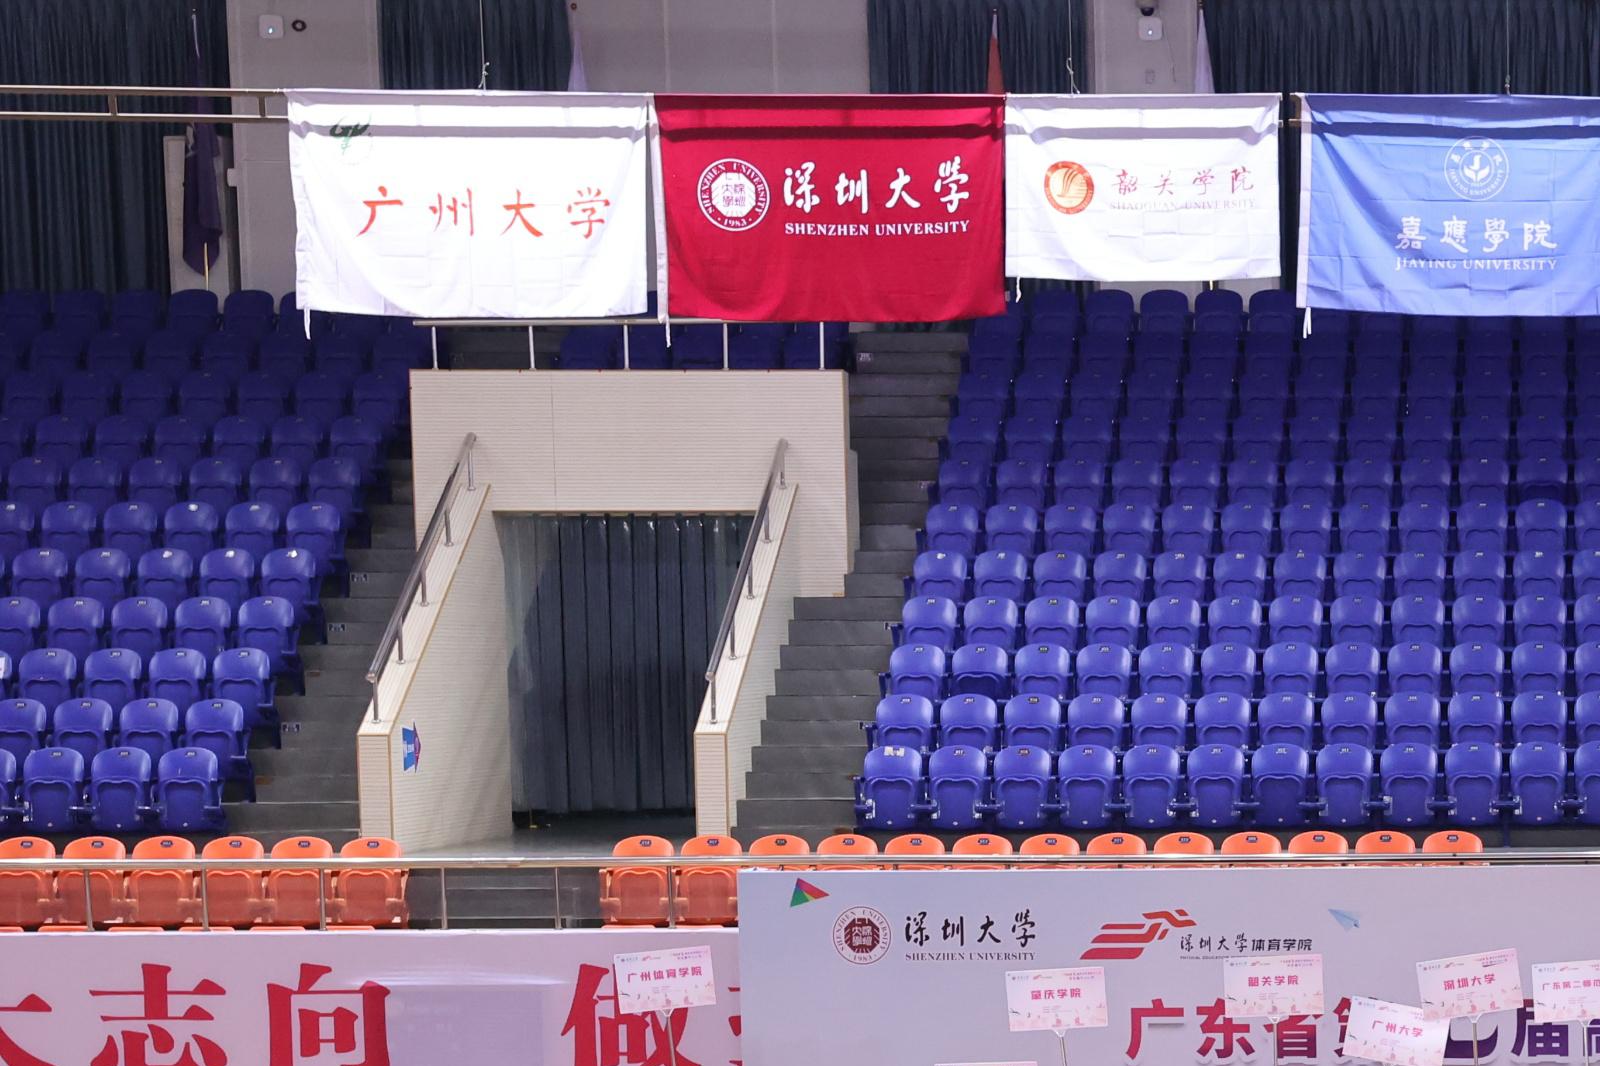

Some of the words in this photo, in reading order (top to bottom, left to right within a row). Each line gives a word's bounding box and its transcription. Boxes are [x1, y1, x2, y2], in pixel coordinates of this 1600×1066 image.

[701, 162, 726, 215] SHENZHEN
[732, 162, 768, 214] UNIVERSITY
[783, 155, 970, 213] 深圳大学
[1112, 166, 1254, 196] 韶关学院
[356, 185, 611, 239] 广州大学
[1185, 198, 1256, 209] UNIVERSITY
[785, 222, 869, 236] SHENZHEN
[875, 220, 970, 236] UNIVERSITY
[1395, 215, 1558, 253] 嘉應學院
[1395, 257, 1457, 271] JIAYING
[1463, 259, 1557, 271] UNIVERSITY
[905, 908, 1036, 947] 深圳大学
[1180, 933, 1312, 952] 深圳大学体育学院
[905, 952, 965, 961] SHENZHEN
[969, 952, 1036, 961] UNIVERSITY
[627, 966, 703, 983] 广州体育学院
[1248, 975, 1299, 988] 韶关学院
[1443, 973, 1495, 991] 深圳大学
[1031, 987, 1083, 1001] 肇庆学院
[1370, 1020, 1425, 1038] 广州大学
